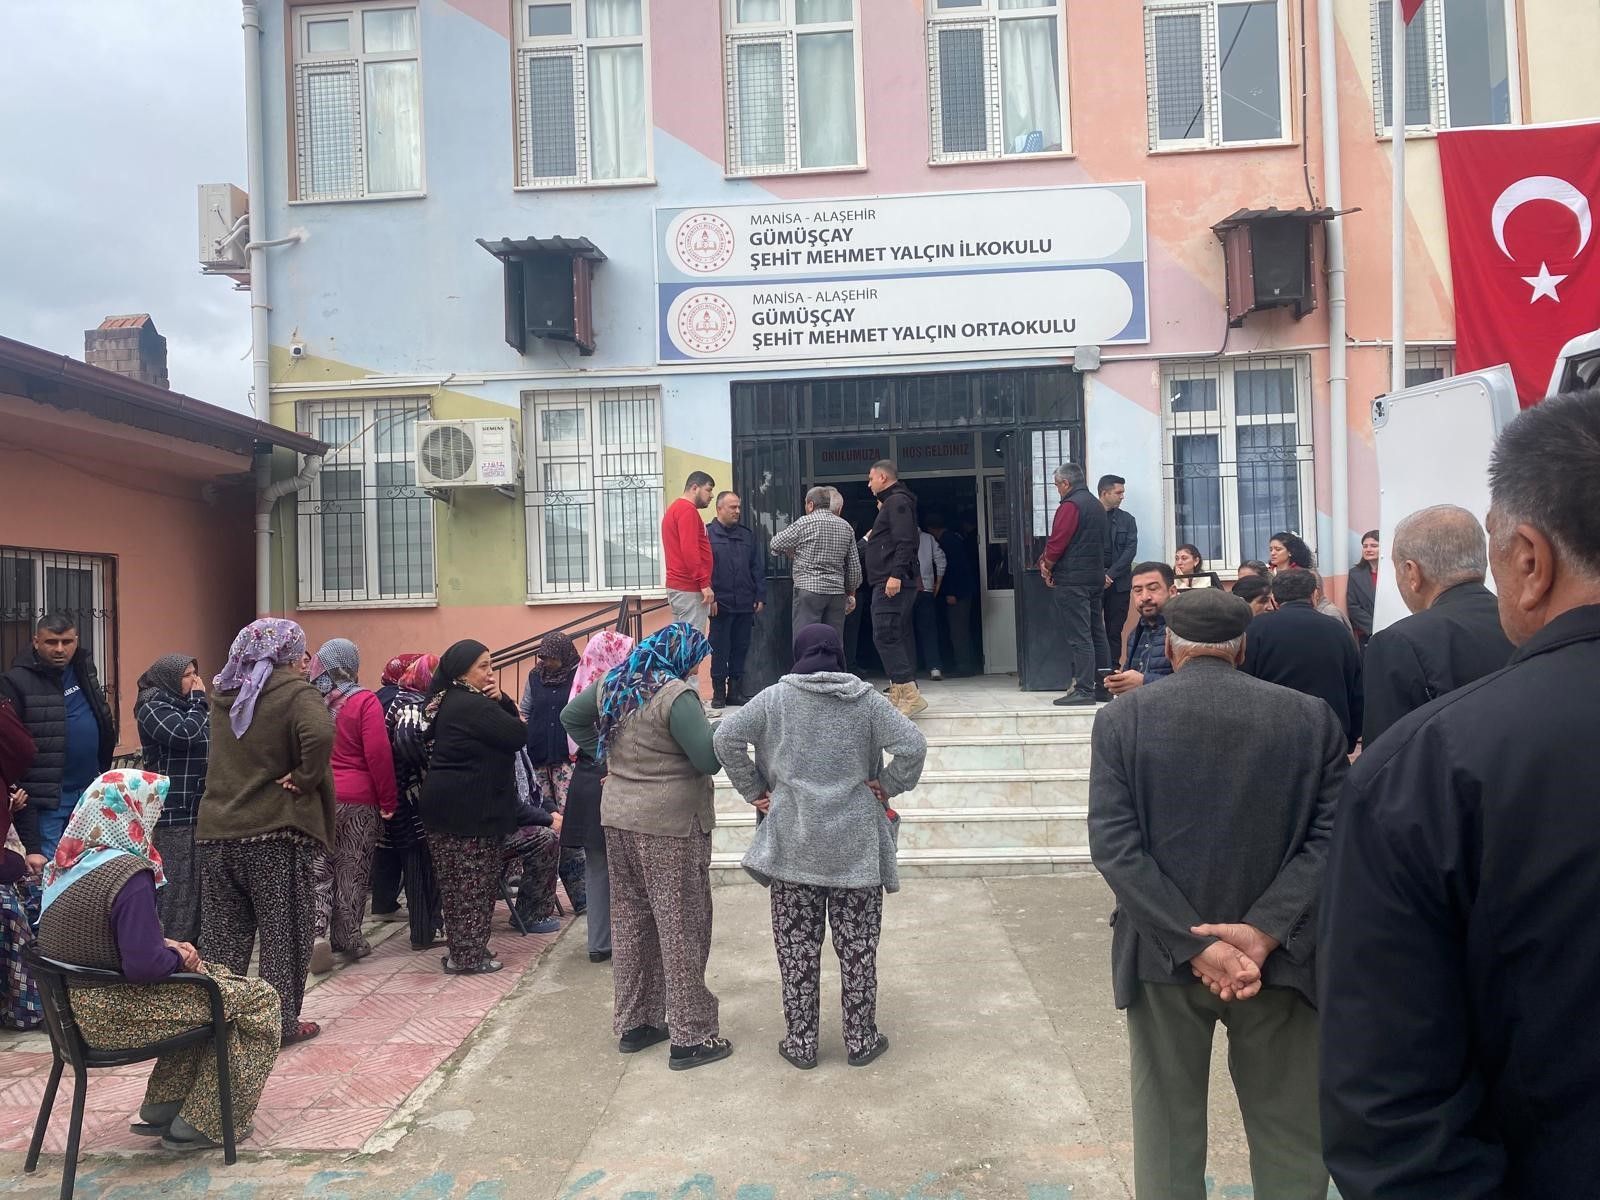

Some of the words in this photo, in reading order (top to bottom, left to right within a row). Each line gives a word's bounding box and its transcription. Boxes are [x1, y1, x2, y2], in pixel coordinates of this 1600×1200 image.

[750, 212, 802, 225] MANİSA
[813, 208, 876, 223] ALAŞEHİR
[749, 227, 854, 248] GÜMÜŞÇAY
[750, 248, 802, 271] ŞEHİT
[806, 247, 887, 265] MEHMET
[889, 244, 954, 263] YALÇIN
[959, 238, 1052, 257] İLKOKULU
[752, 291, 805, 305] MANİSA
[815, 287, 878, 304] ALAŞEHİR
[751, 307, 856, 328] GÜMÜŞÇAY
[752, 328, 804, 351] ŞEHİT
[808, 327, 889, 346] MEHMET
[891, 324, 956, 344] YALÇIN
[961, 318, 1076, 339] ORTAOKULU
